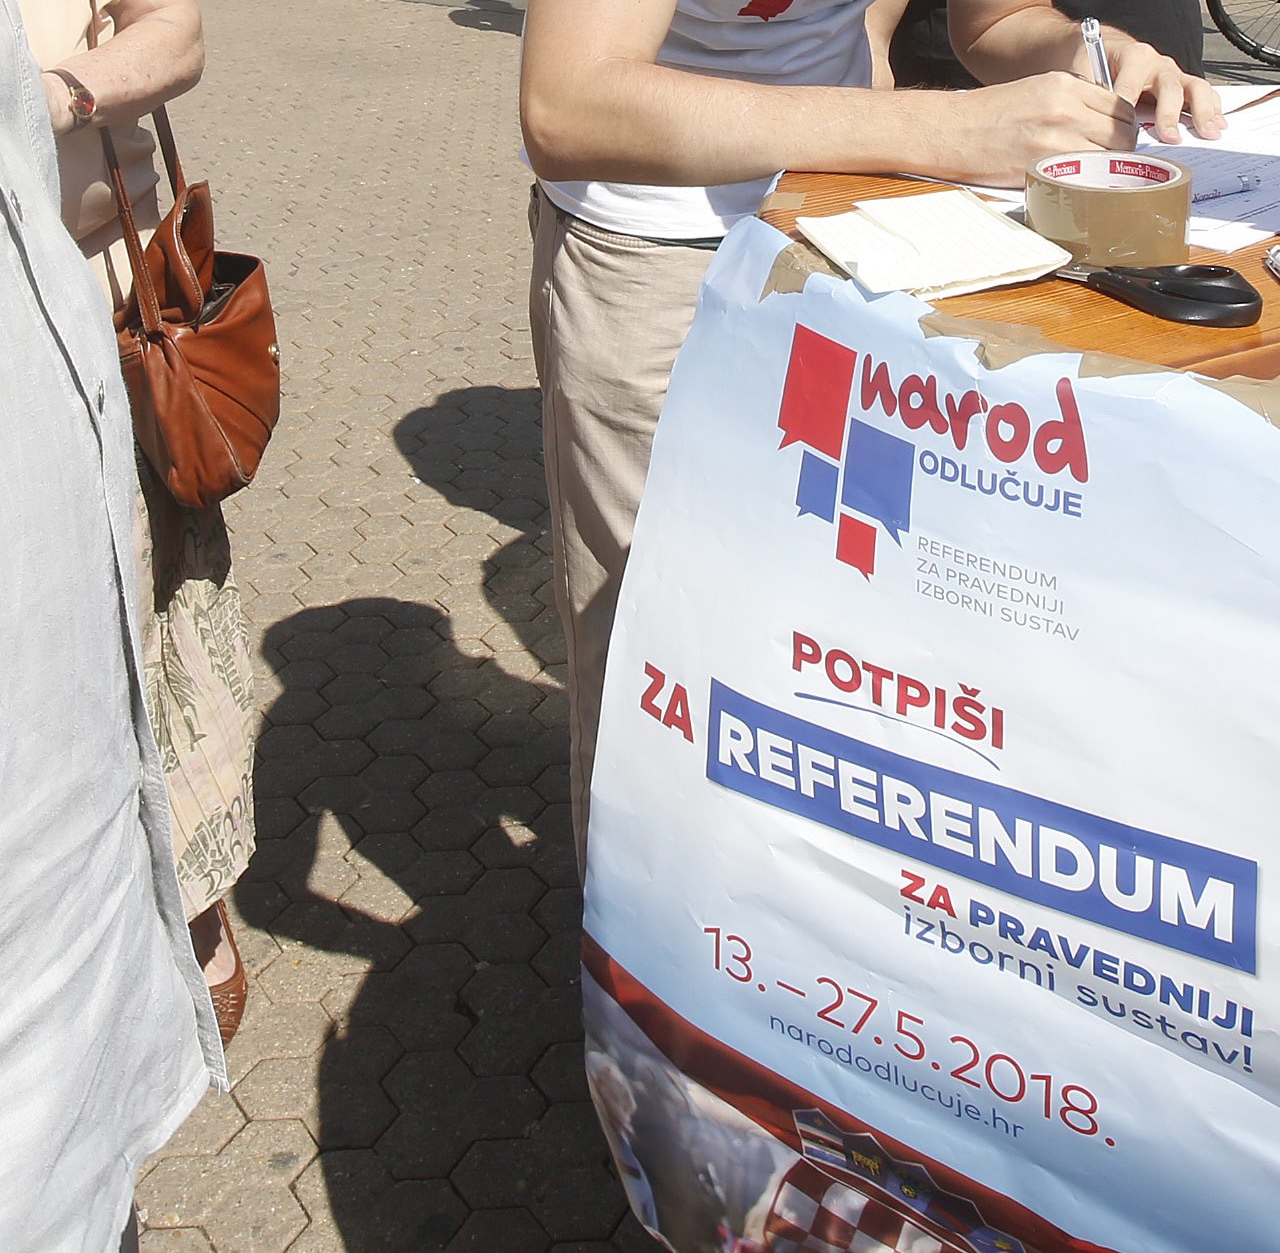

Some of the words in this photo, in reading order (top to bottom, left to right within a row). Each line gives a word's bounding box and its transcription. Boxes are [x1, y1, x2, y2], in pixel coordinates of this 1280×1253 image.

[860, 353, 1089, 484] narod
[918, 449, 1083, 518] ODLUČUJE
[916, 557, 941, 579] ZA
[945, 566, 1064, 616] PRAVEDNIJI
[916, 579, 993, 618] IZBORNI
[1000, 606, 1081, 642] SUSTAV
[917, 535, 1058, 591] REFERENDUM
[792, 629, 1005, 751] POTPIŠI
[640, 660, 695, 745] ZA
[717, 708, 1236, 945] REFERENDUM
[899, 869, 959, 920] ZA
[968, 898, 1255, 1039] PRAVEDNIJI
[903, 905, 1056, 992] izborni
[1077, 980, 1255, 1074] sustav!
[768, 1013, 1025, 1139] narododlucuje.hr
